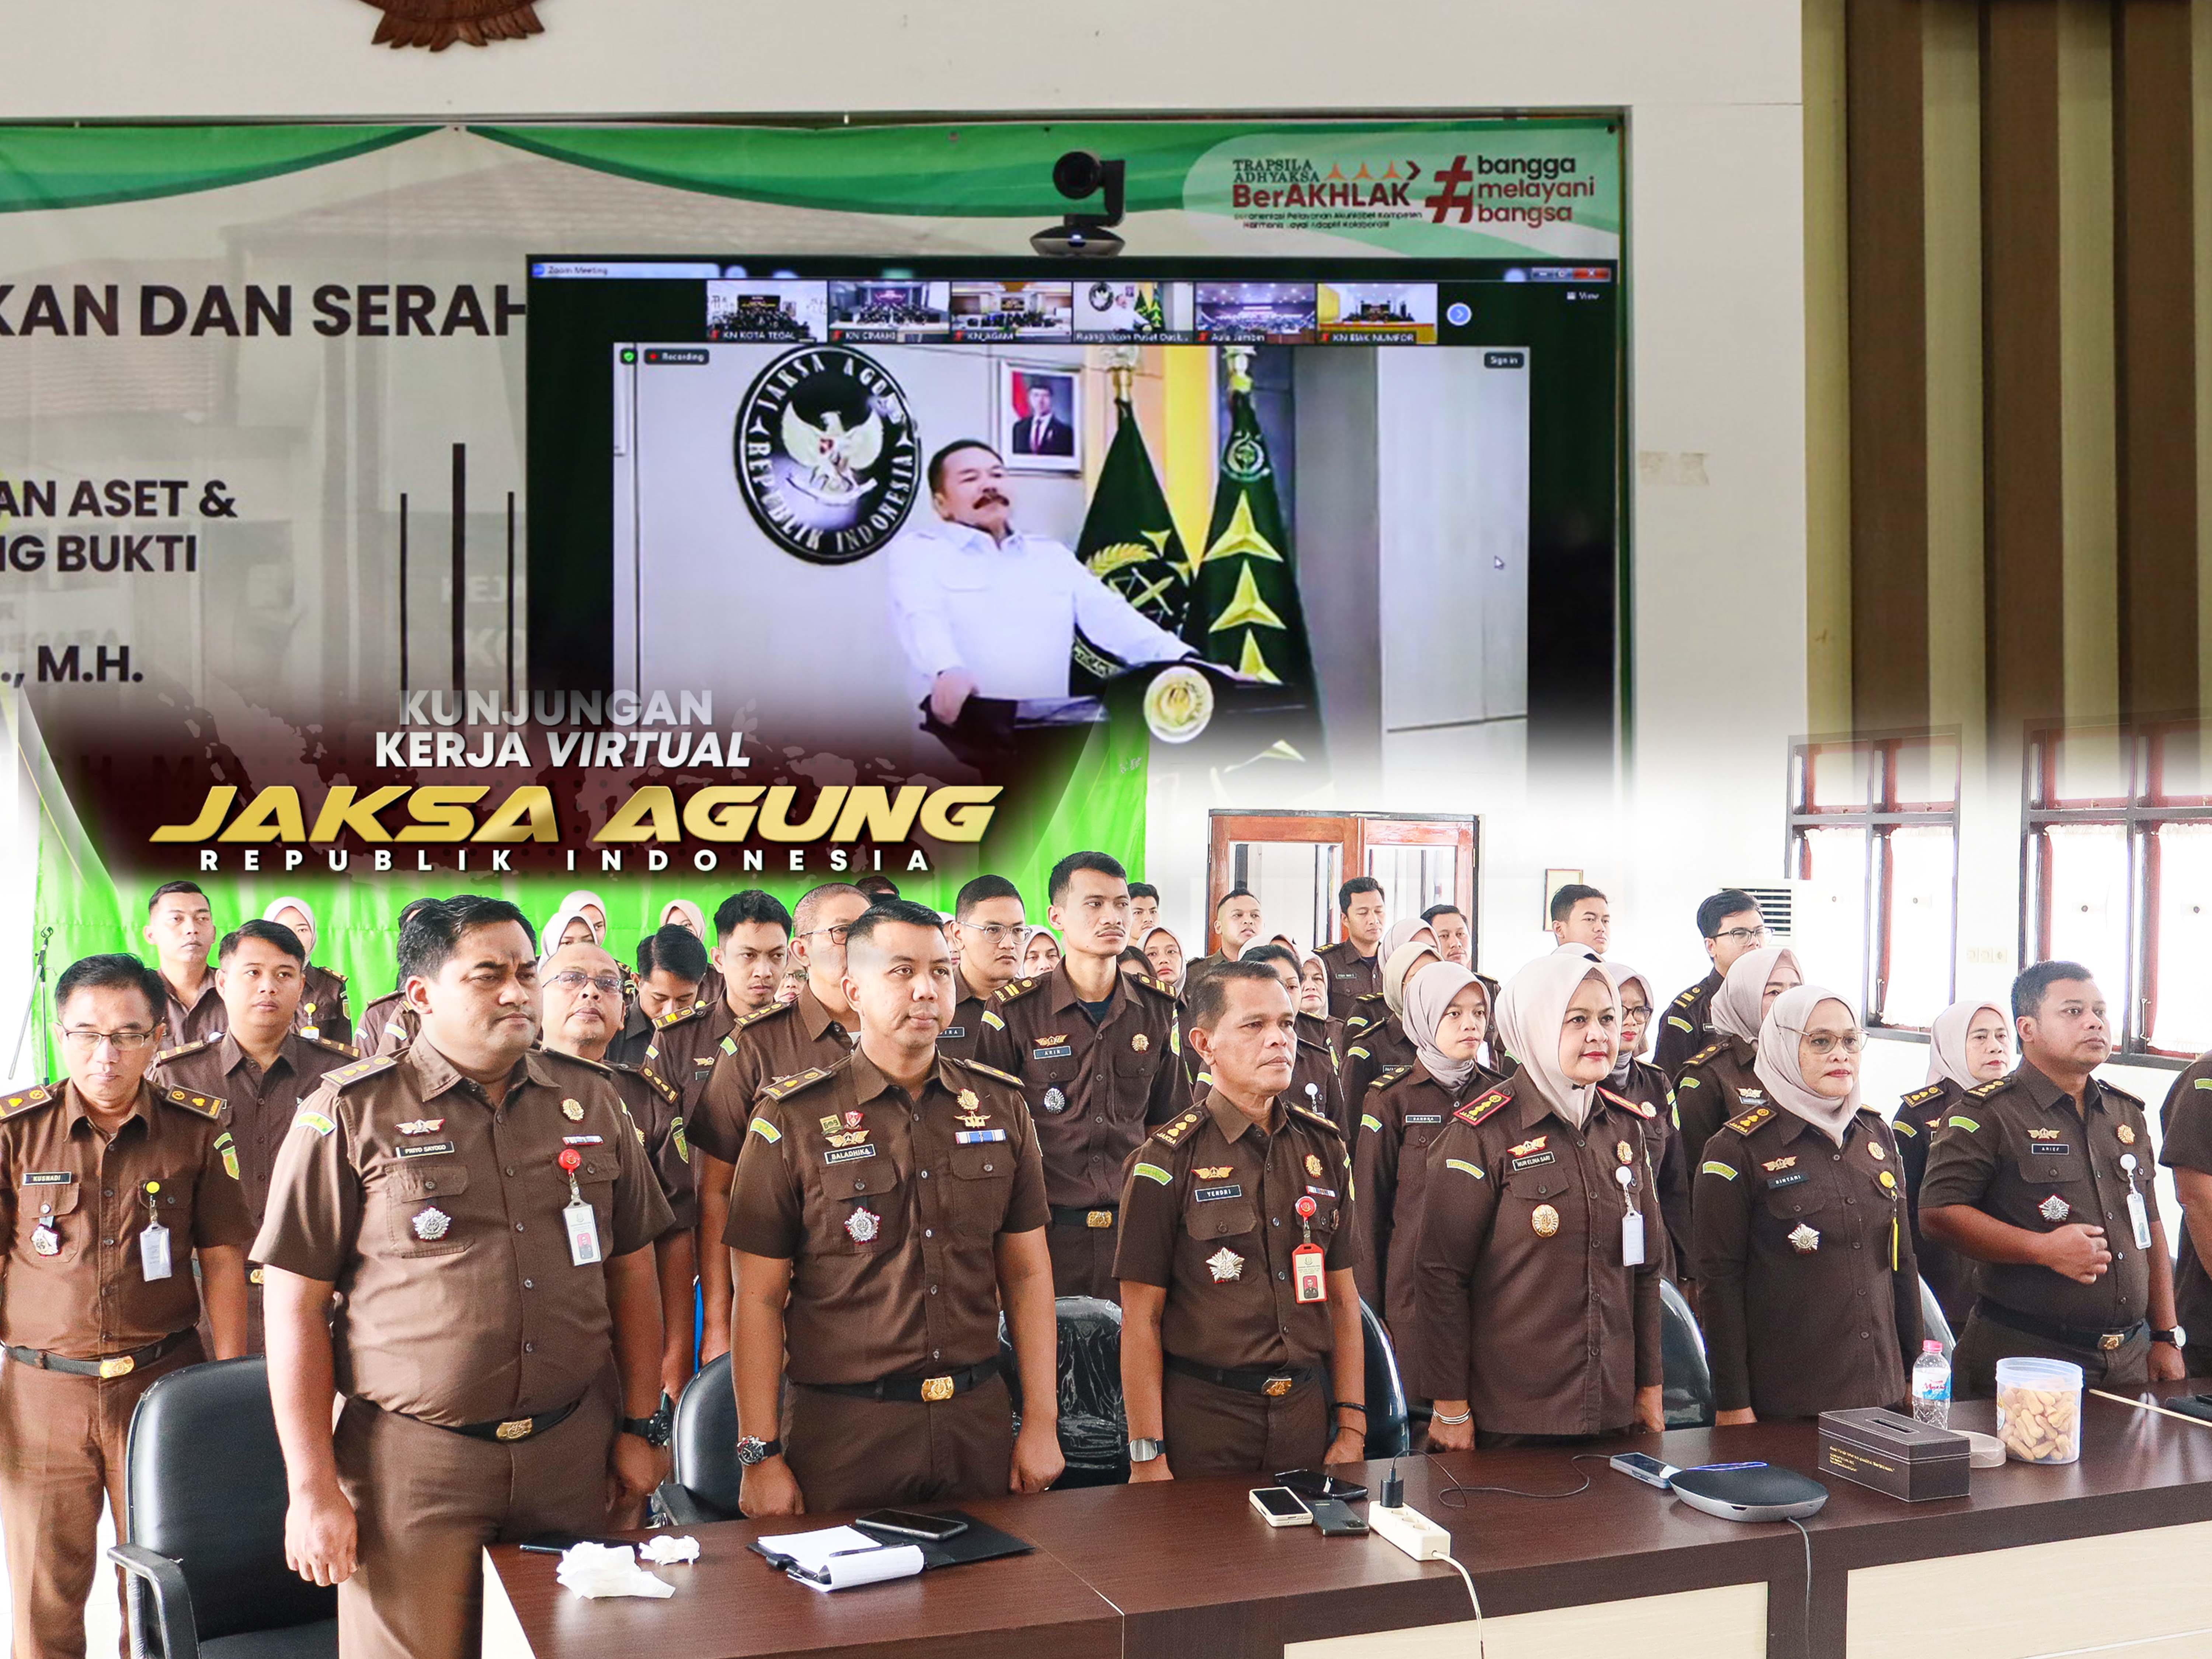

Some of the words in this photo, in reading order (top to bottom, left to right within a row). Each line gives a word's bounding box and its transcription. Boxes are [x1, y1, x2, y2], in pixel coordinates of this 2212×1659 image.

[1232, 160, 1313, 172] TRAPSILA
[1234, 171, 1320, 183] ADHYAKSA
[1478, 155, 1576, 180] bangga
[1233, 183, 1411, 208] BerAKHLAK
[1478, 177, 1594, 203] melayani
[1478, 202, 1572, 227] bangsa
[140, 285, 292, 336] DAN
[68, 480, 188, 517] ASET
[199, 480, 237, 517] &
[0, 535, 45, 572] G
[58, 535, 196, 572] BUKTI
[38, 646, 143, 682] M.H.
[1156, 1132, 1177, 1145] JAKSA
[831, 1148, 871, 1160] BALADHIKA
[1207, 1189, 1231, 1197] YENDRI
